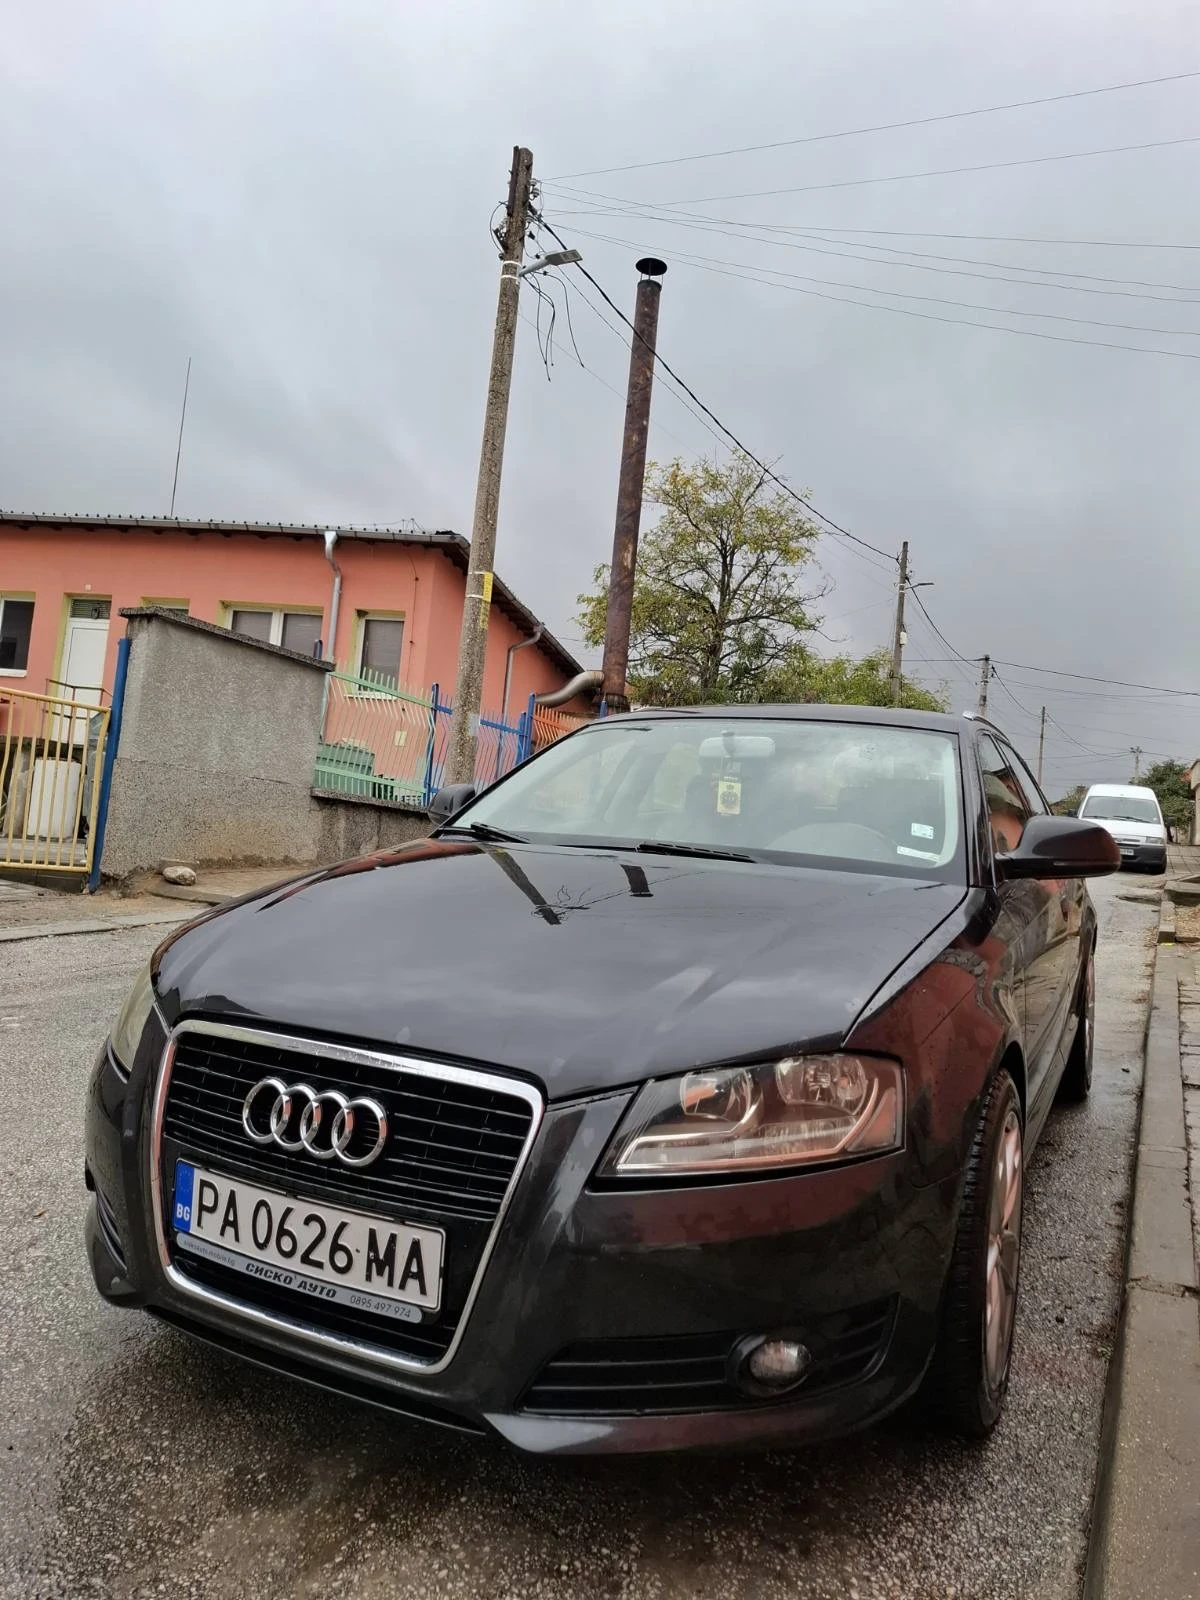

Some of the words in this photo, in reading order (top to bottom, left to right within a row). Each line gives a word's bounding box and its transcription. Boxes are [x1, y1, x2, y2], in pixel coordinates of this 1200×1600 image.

[176, 1203, 191, 1220] BG
[197, 1178, 240, 1242] PA
[251, 1198, 354, 1275] 0626
[365, 1227, 428, 1296] MA
[245, 1262, 293, 1286] СИСКО
[350, 1295, 372, 1308] 0895
[374, 1302, 392, 1312] 497
[394, 1307, 411, 1318] 974
